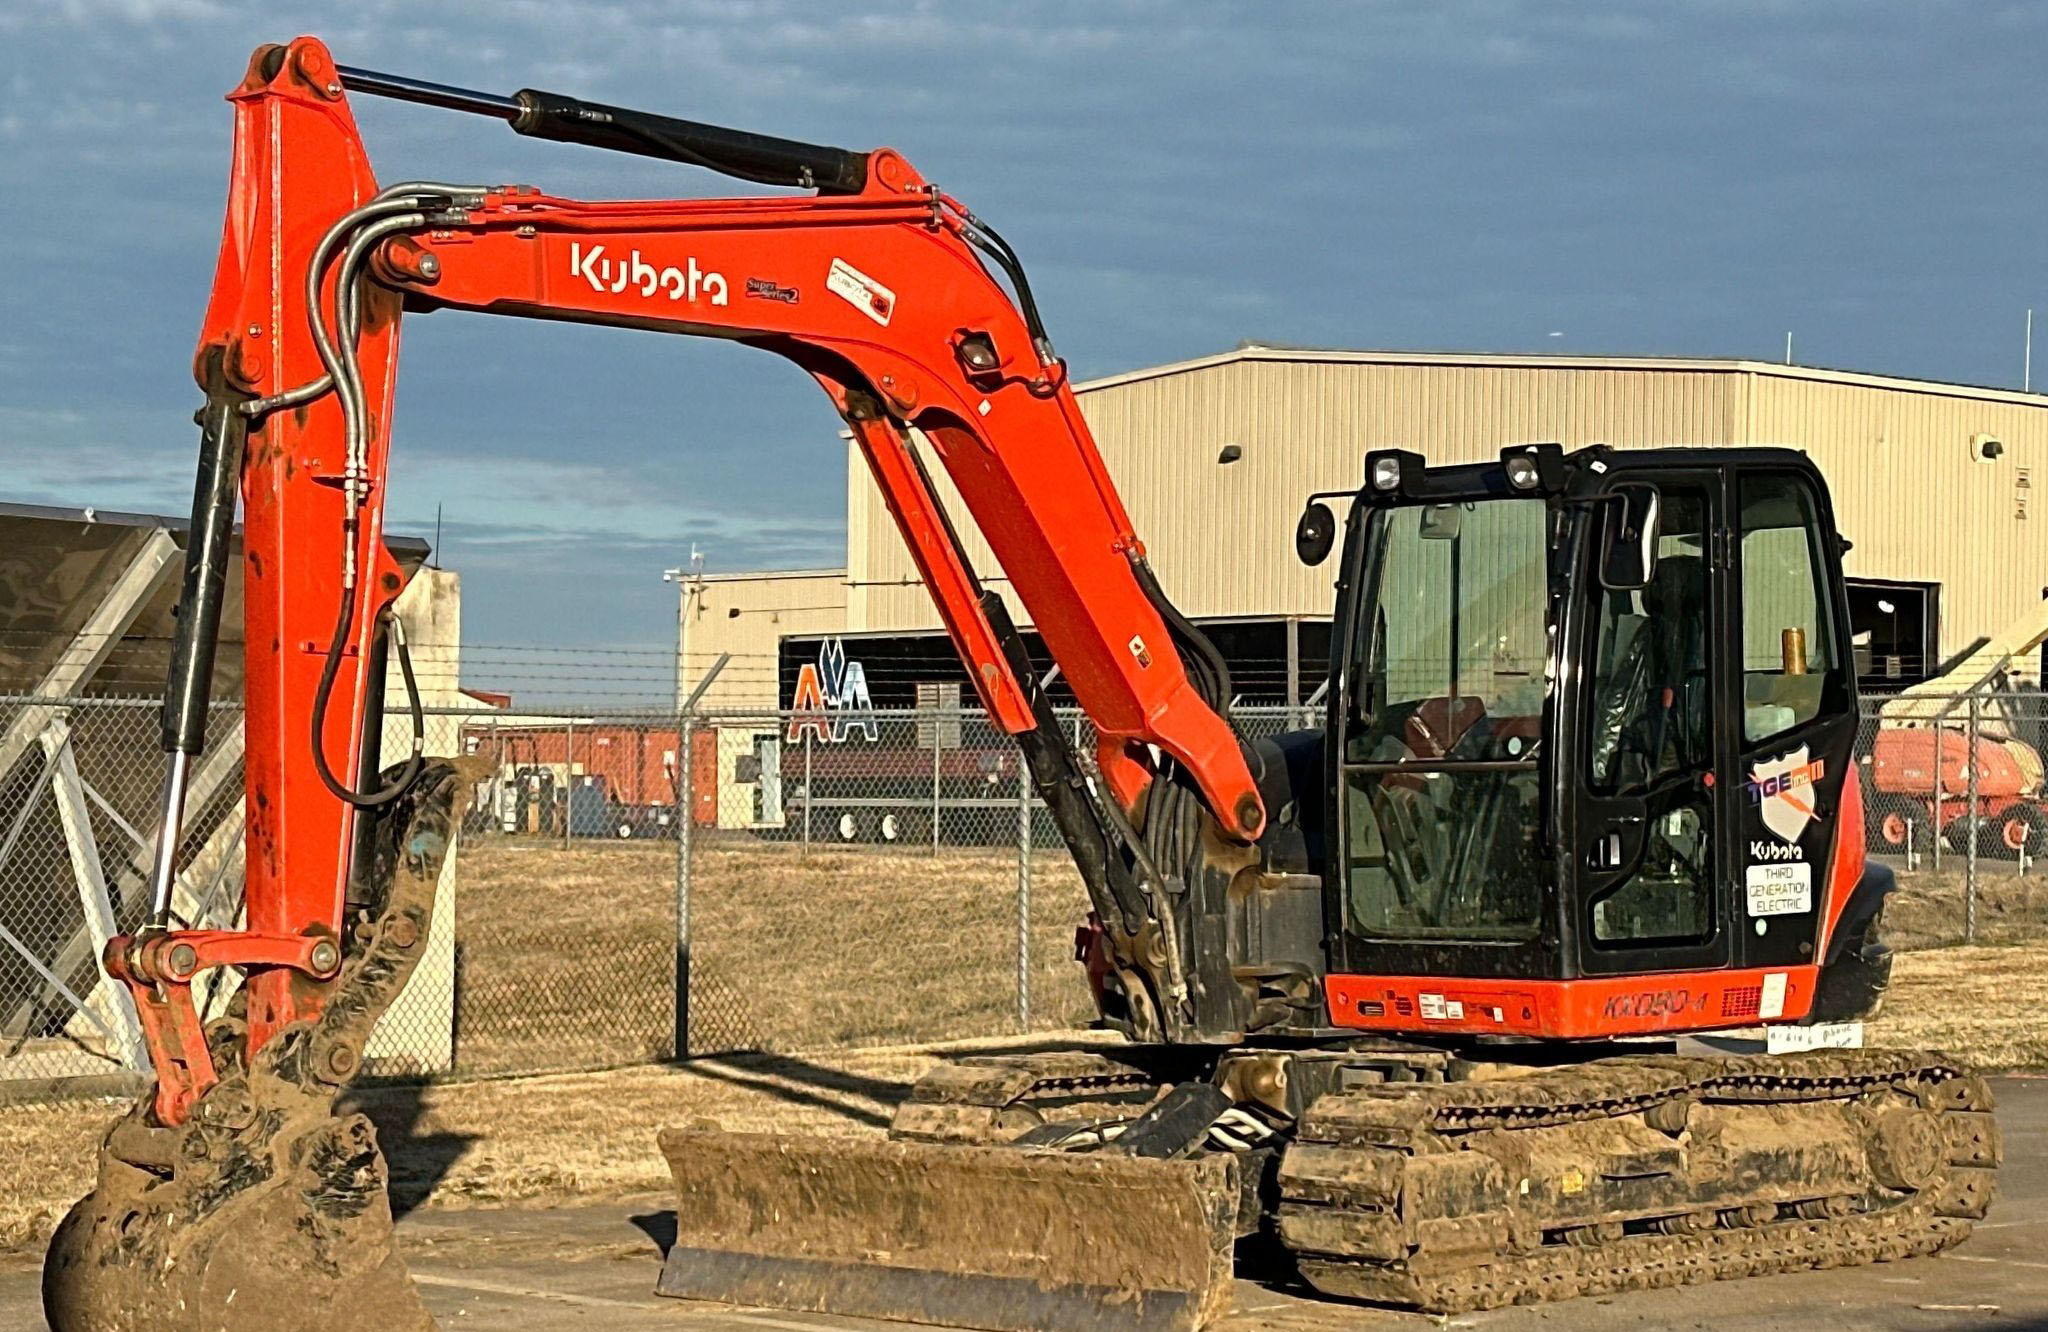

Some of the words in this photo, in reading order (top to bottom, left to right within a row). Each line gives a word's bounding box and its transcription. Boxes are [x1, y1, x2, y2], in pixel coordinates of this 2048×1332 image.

[571, 242, 728, 306] Kubota
[1747, 771, 1792, 803] TGE
[1750, 841, 1803, 860] Kubota
[1765, 867, 1794, 879] THIRD
[1749, 882, 1809, 898] GENERATION
[1756, 898, 1803, 913] ELECTRIC
